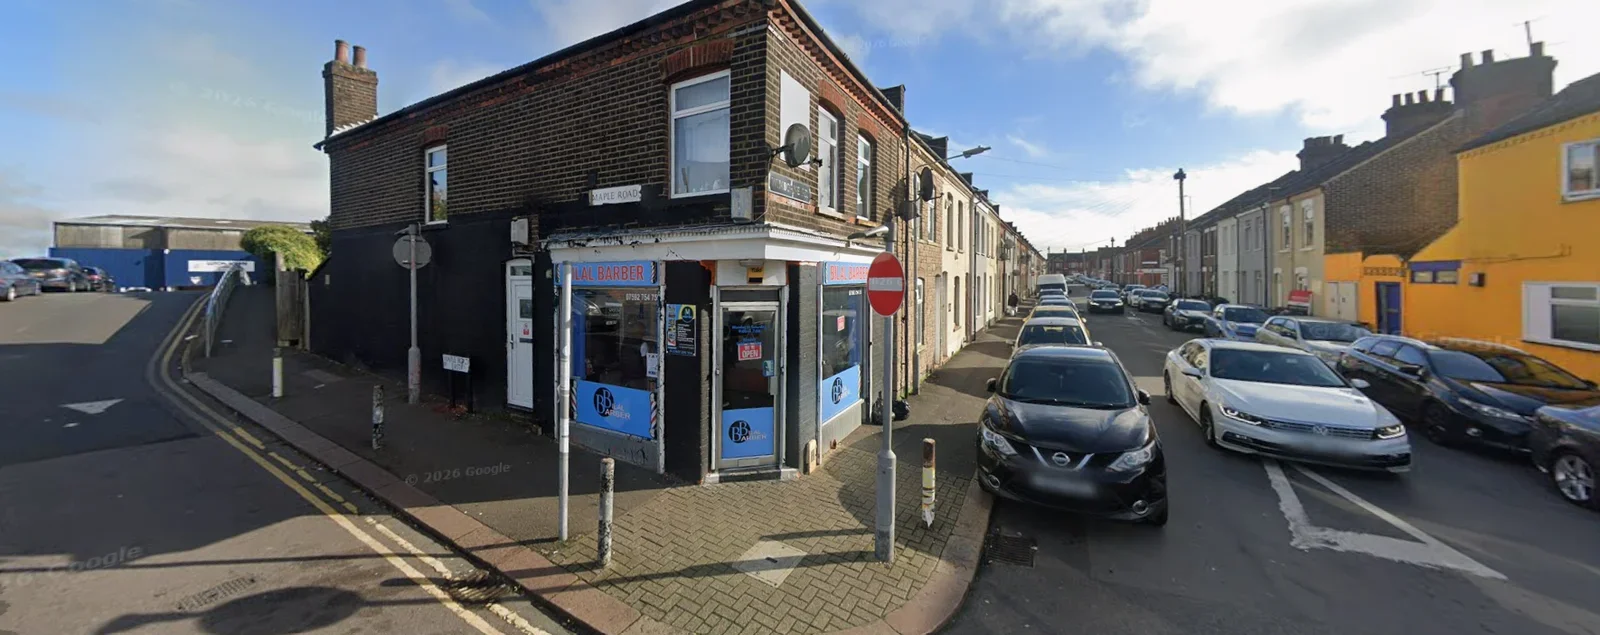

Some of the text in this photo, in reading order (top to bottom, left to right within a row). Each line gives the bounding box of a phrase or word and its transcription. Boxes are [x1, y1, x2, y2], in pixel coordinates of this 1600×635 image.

[593, 189, 638, 202] MAPLE ROAD
[572, 265, 644, 282] ILAL BARBER
[830, 265, 847, 281] BILAL
[742, 350, 759, 358] OPEN
